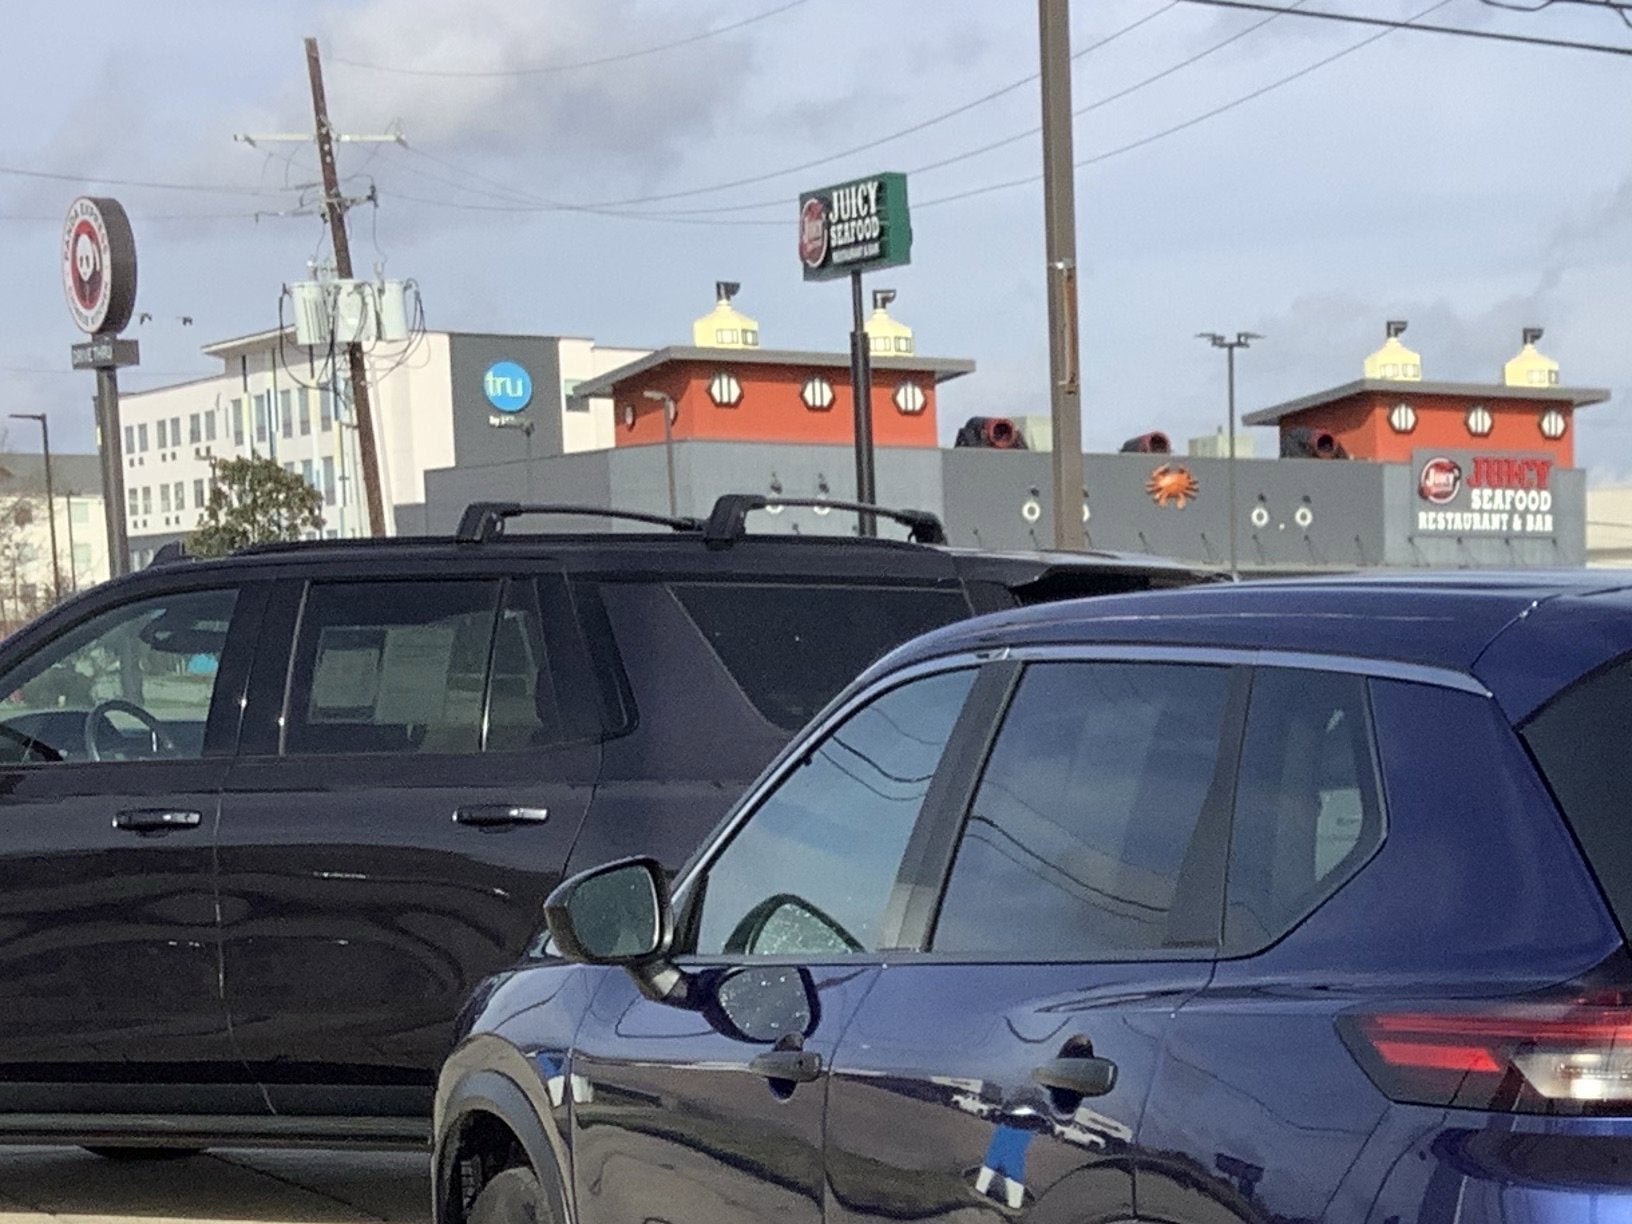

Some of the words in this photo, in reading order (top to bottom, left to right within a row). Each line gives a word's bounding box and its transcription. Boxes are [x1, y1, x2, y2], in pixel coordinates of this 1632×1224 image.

[828, 180, 879, 222] JUICY
[829, 215, 880, 248] SEAFOOD
[484, 370, 524, 398] tru
[1466, 456, 1553, 488] JUICY
[1471, 488, 1552, 512] SEAFOOD
[1418, 511, 1509, 531] RESTAURANT
[1512, 513, 1523, 531] &
[1526, 513, 1553, 532] BAR
